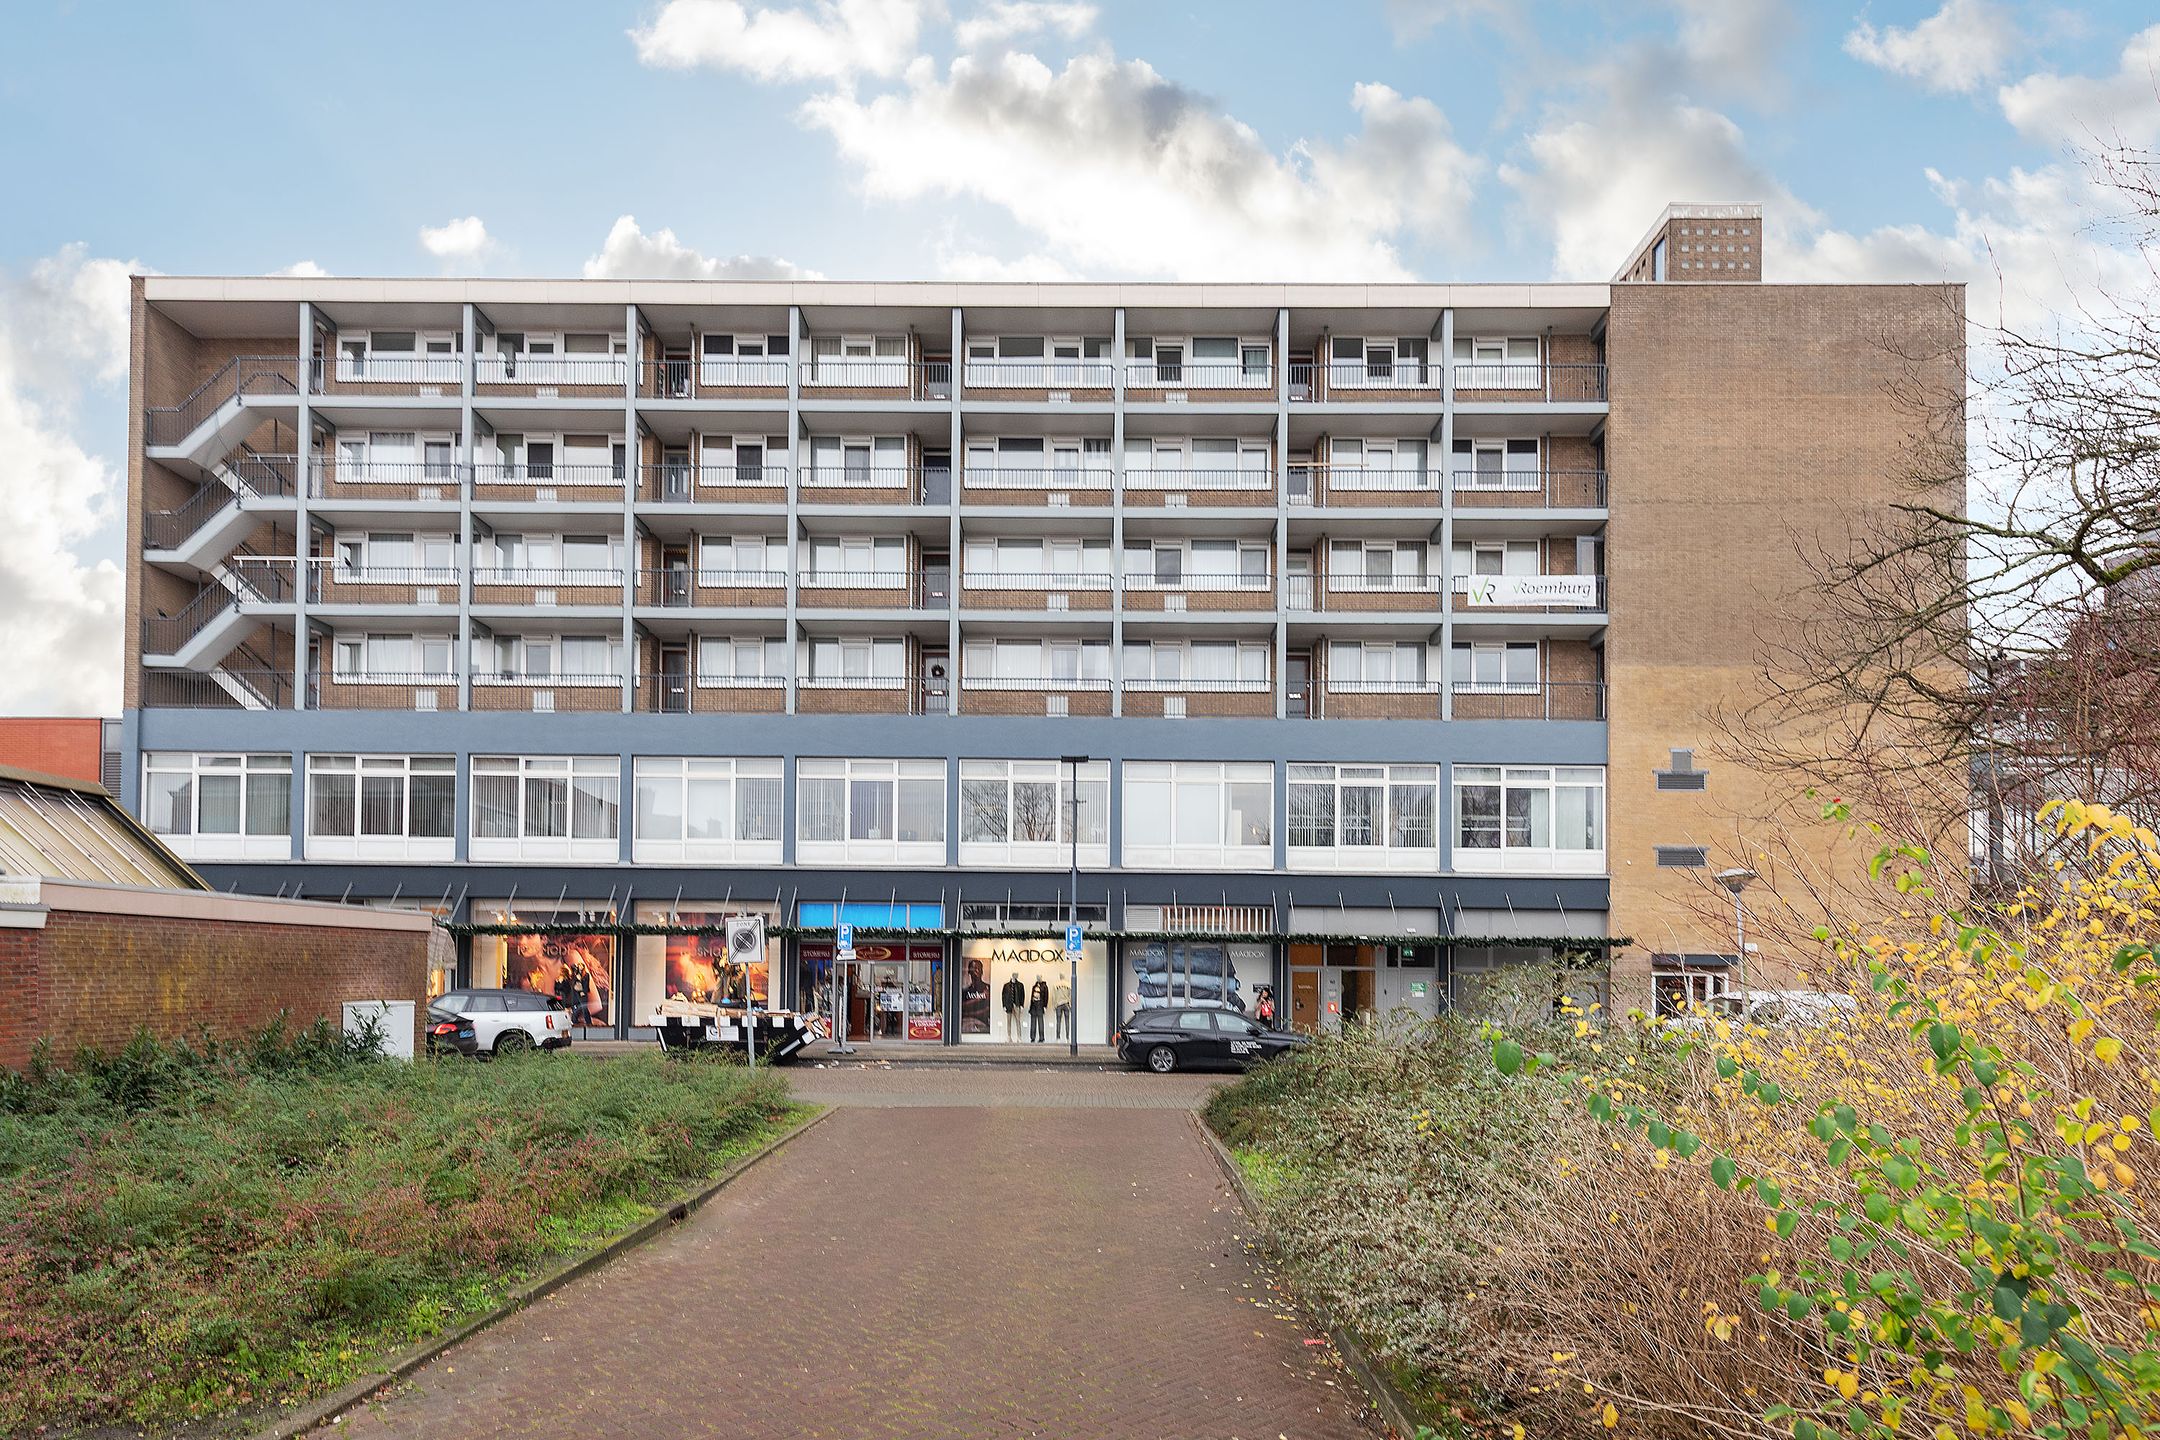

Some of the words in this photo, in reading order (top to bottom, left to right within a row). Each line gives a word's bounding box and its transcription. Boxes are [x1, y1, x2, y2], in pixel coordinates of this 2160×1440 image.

[841, 925, 850, 939] P
[1069, 928, 1079, 942] P
[992, 948, 1066, 963] MADDOX
[1229, 950, 1266, 959] MADDOX
